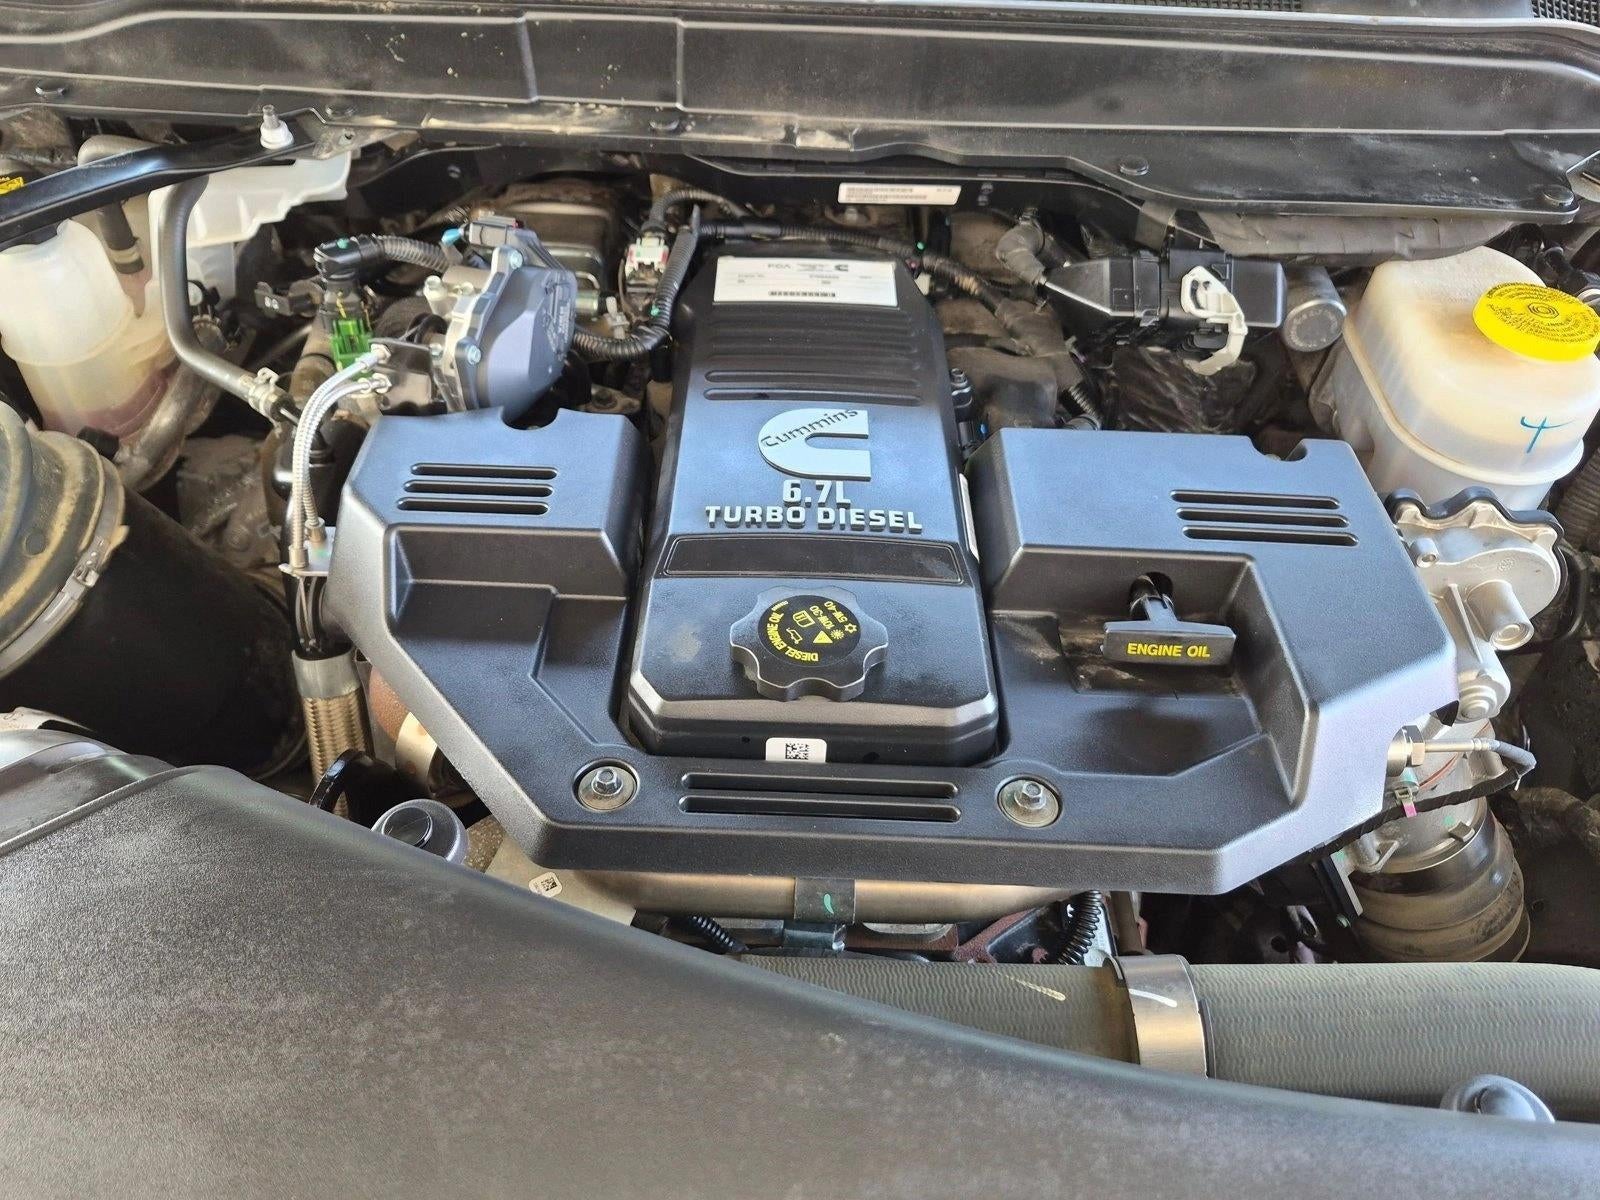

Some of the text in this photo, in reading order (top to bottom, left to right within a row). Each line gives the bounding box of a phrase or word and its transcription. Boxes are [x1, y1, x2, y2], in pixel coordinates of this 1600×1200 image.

[760, 407, 859, 447] Cummins
[783, 480, 851, 508] 6.7L
[705, 506, 923, 534] TURBO DIESEL
[766, 623, 787, 651] ENGINE
[1127, 642, 1211, 658] ENGINE OIL
[784, 646, 819, 662] DIESEL
